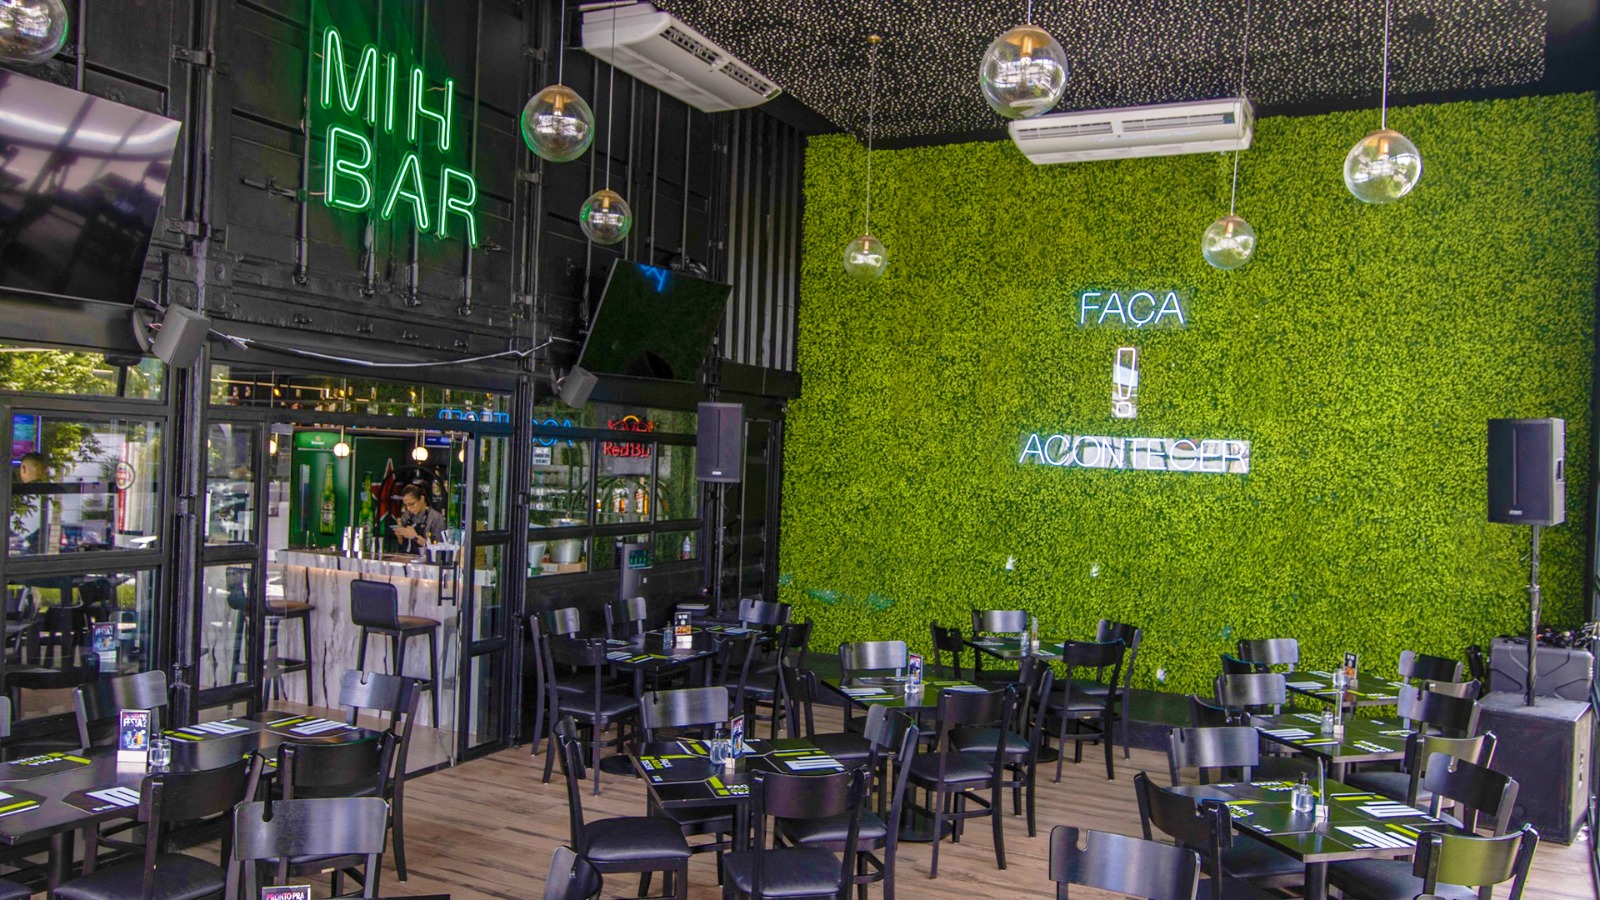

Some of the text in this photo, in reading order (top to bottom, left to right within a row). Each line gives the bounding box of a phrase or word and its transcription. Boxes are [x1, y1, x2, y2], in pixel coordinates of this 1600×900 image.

[321, 26, 455, 153] MIH
[324, 122, 479, 249] BAR
[1080, 292, 1186, 328] FAÇA
[603, 441, 651, 458] Red Bu
[1019, 433, 1249, 472] ACONTECER
[292, 891, 305, 900] PRA
